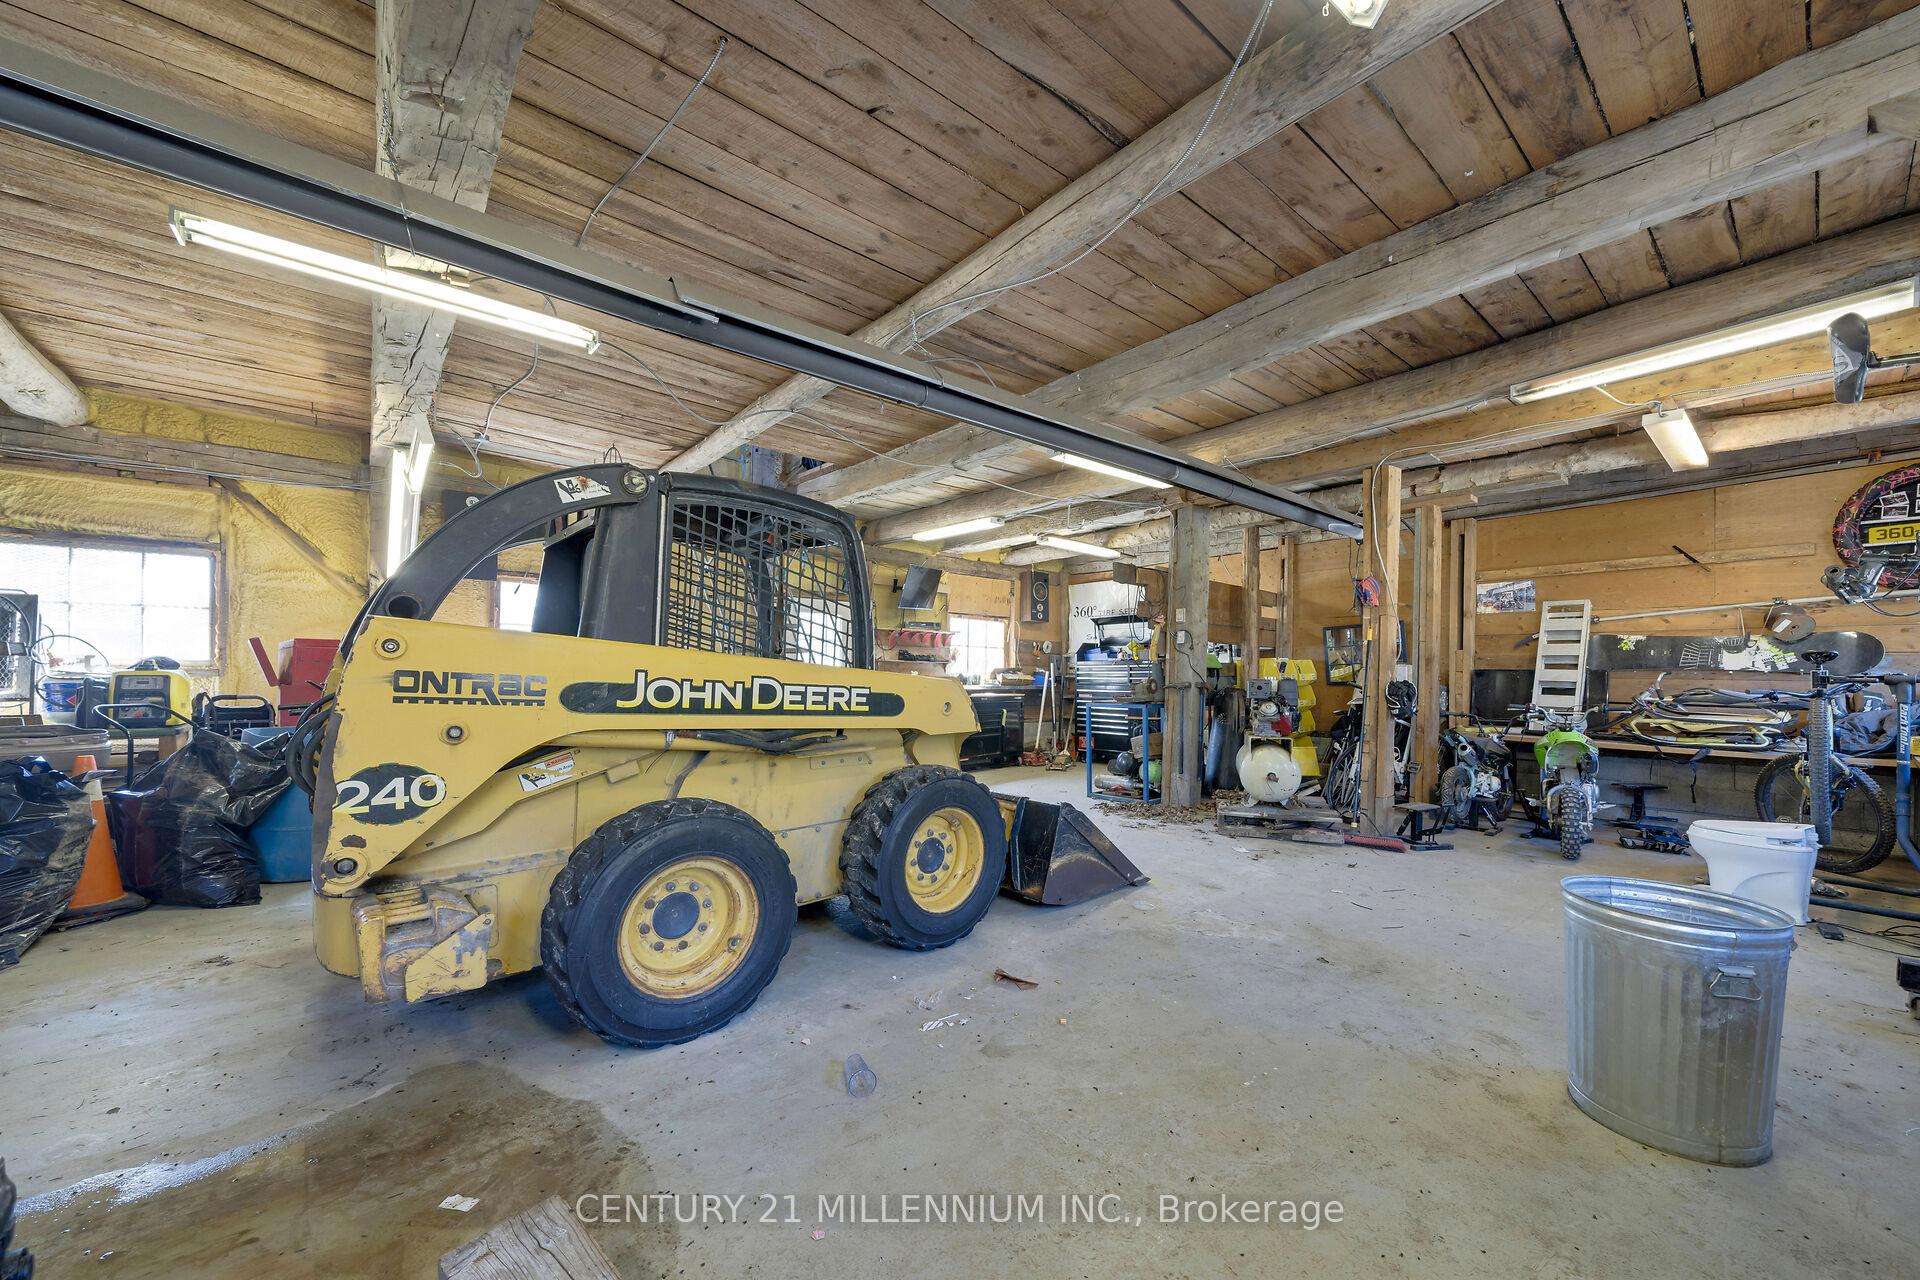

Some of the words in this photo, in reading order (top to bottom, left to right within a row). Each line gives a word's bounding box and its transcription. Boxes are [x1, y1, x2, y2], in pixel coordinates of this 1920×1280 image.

[616, 669, 743, 710] JOHN
[751, 675, 871, 712] DEERE
[332, 774, 447, 815] 240
